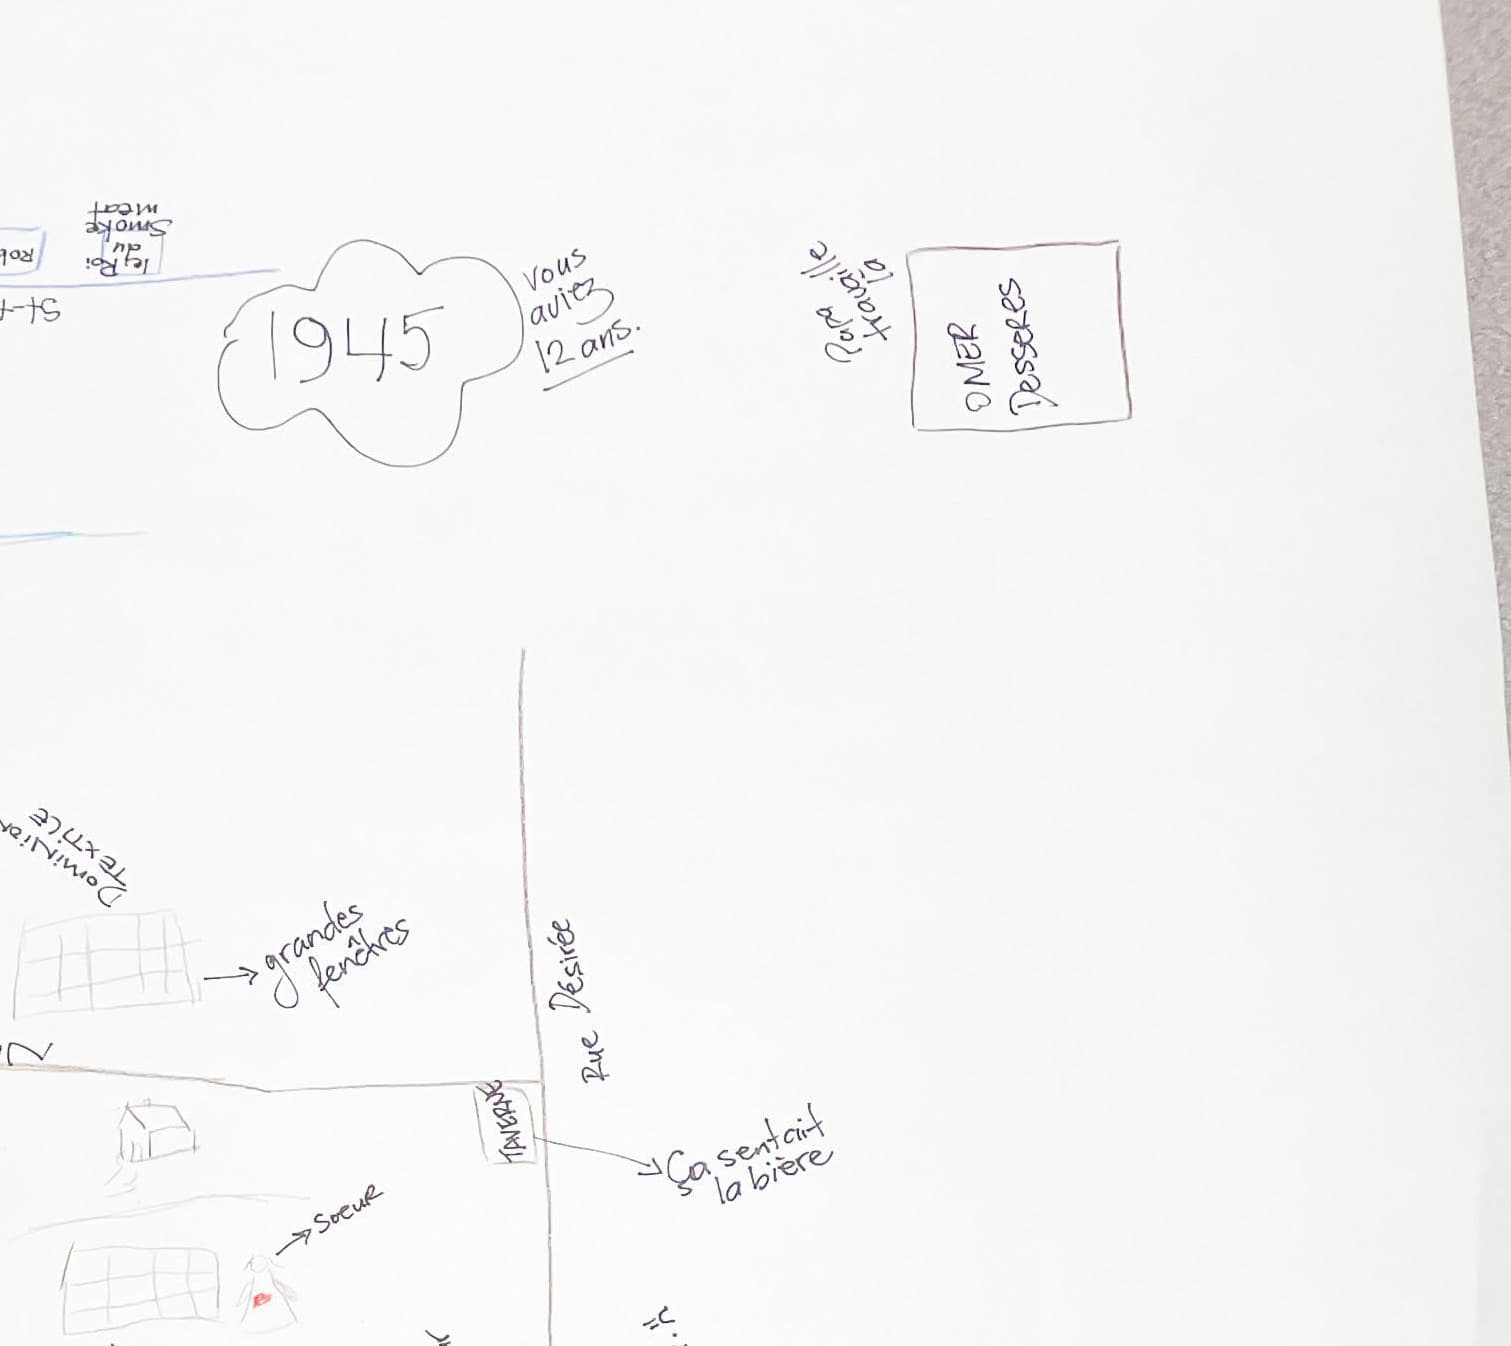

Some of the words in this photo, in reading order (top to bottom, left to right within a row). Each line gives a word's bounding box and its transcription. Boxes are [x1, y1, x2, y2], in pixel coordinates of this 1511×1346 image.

[85, 219, 172, 242] Smoke
[87, 201, 158, 223] meat
[85, 256, 118, 277] Roi
[113, 243, 142, 253] du
[523, 248, 587, 291] vous
[530, 277, 615, 325] aviez
[800, 241, 892, 341] travaille
[269, 305, 444, 384] 1945
[535, 338, 575, 373] 12
[816, 306, 862, 363] Papa
[947, 322, 992, 413] OMER
[264, 900, 364, 1010] grandes
[580, 1030, 610, 1084] Rue
[475, 1079, 523, 1163] TAVERNE
[717, 1101, 826, 1168] sentait
[715, 1177, 742, 1205] la
[748, 1147, 834, 1191] bière
